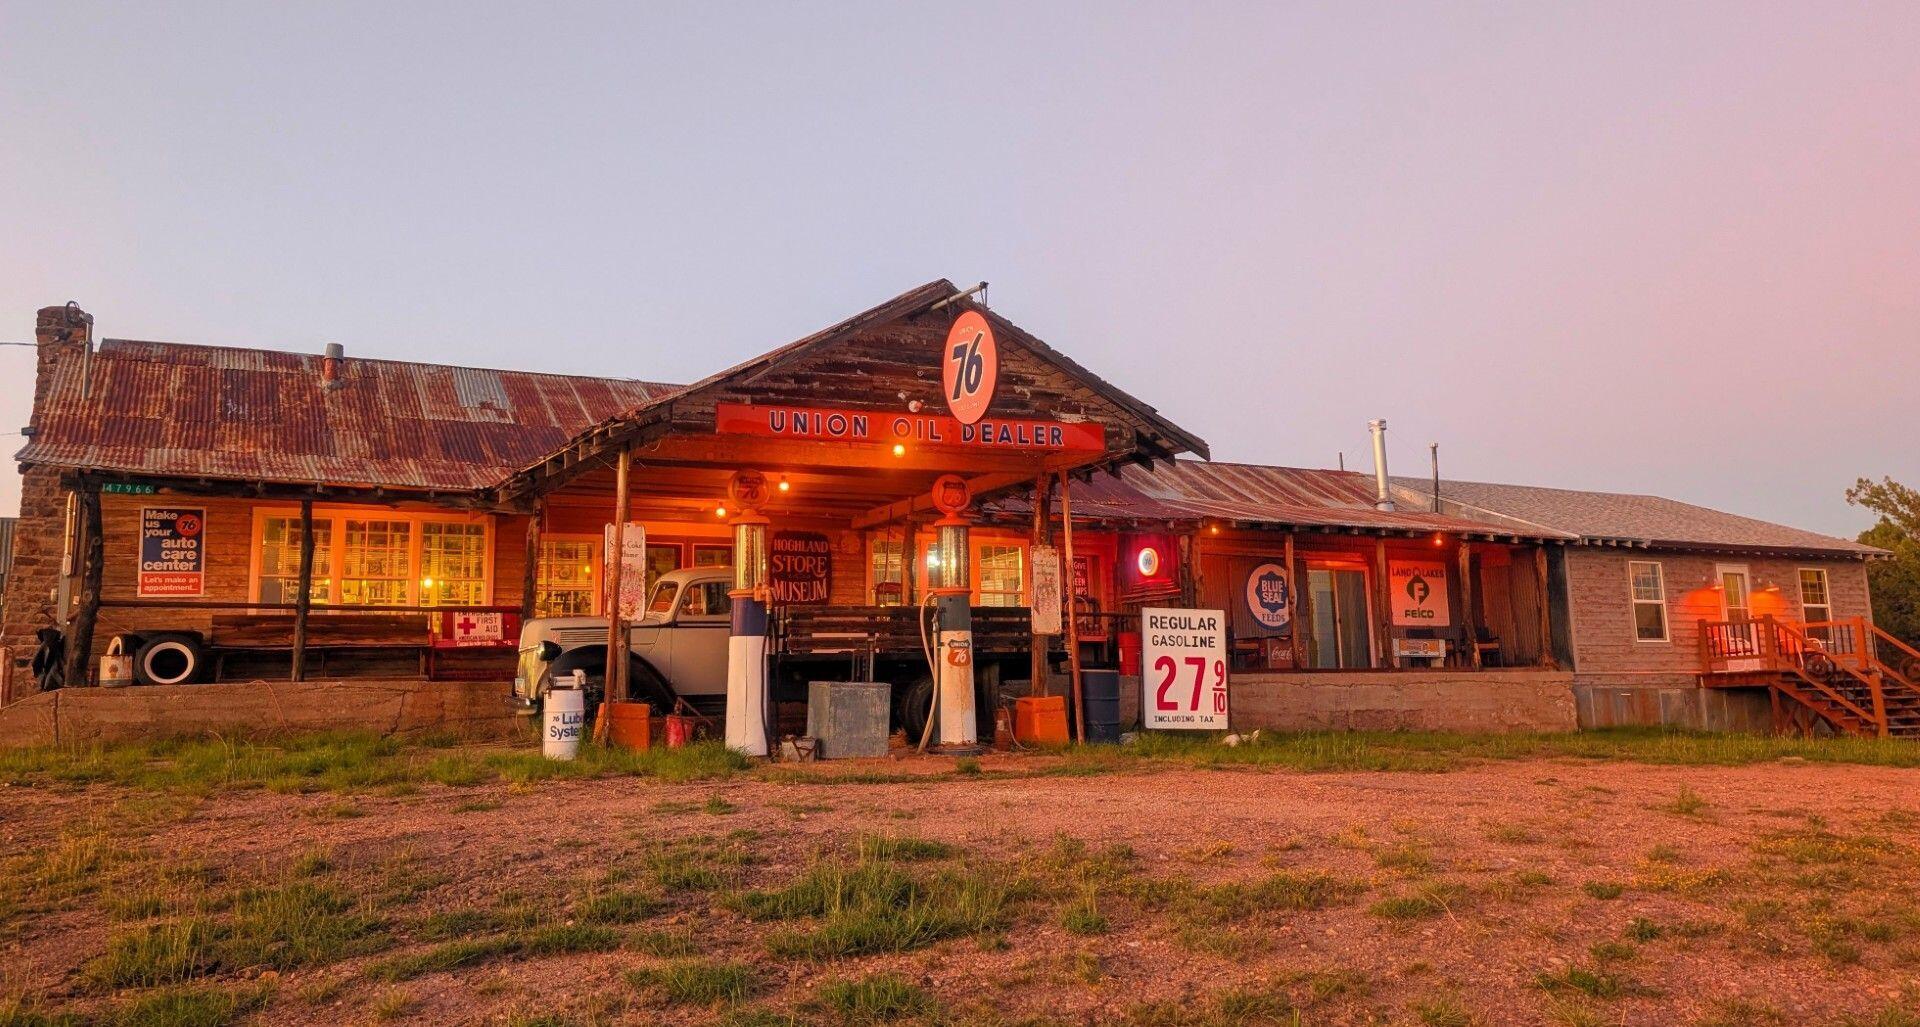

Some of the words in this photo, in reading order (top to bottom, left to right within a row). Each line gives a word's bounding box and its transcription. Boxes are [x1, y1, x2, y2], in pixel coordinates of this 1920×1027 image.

[951, 330, 984, 402] 76
[769, 410, 868, 437] UNION
[893, 417, 944, 442] OIL
[961, 423, 1065, 446] DEALER
[146, 510, 178, 520] Make
[145, 521, 160, 529] us
[181, 520, 197, 531] 76
[145, 529, 172, 538] your
[161, 537, 197, 549] auto
[161, 550, 197, 560] care
[143, 560, 197, 571] center
[773, 555, 828, 577] STORE
[1392, 568, 1411, 577] LAND
[1423, 569, 1445, 578] LAKES
[772, 577, 828, 602] MUSEUM
[1065, 586, 1088, 596] SMPS
[1261, 580, 1284, 592] BLUE
[1262, 592, 1284, 604] SEAL
[477, 617, 498, 625] FIRST
[1149, 615, 1217, 631] REGULAR
[1262, 613, 1286, 622] FEEDS
[485, 625, 498, 633] AID
[1152, 635, 1216, 648] GASOLINE
[953, 648, 967, 663] 76
[1154, 655, 1206, 712] 27
[562, 713, 583, 725] Lub
[1154, 715, 1195, 723] INCLUDING
[550, 725, 579, 740] Syste
